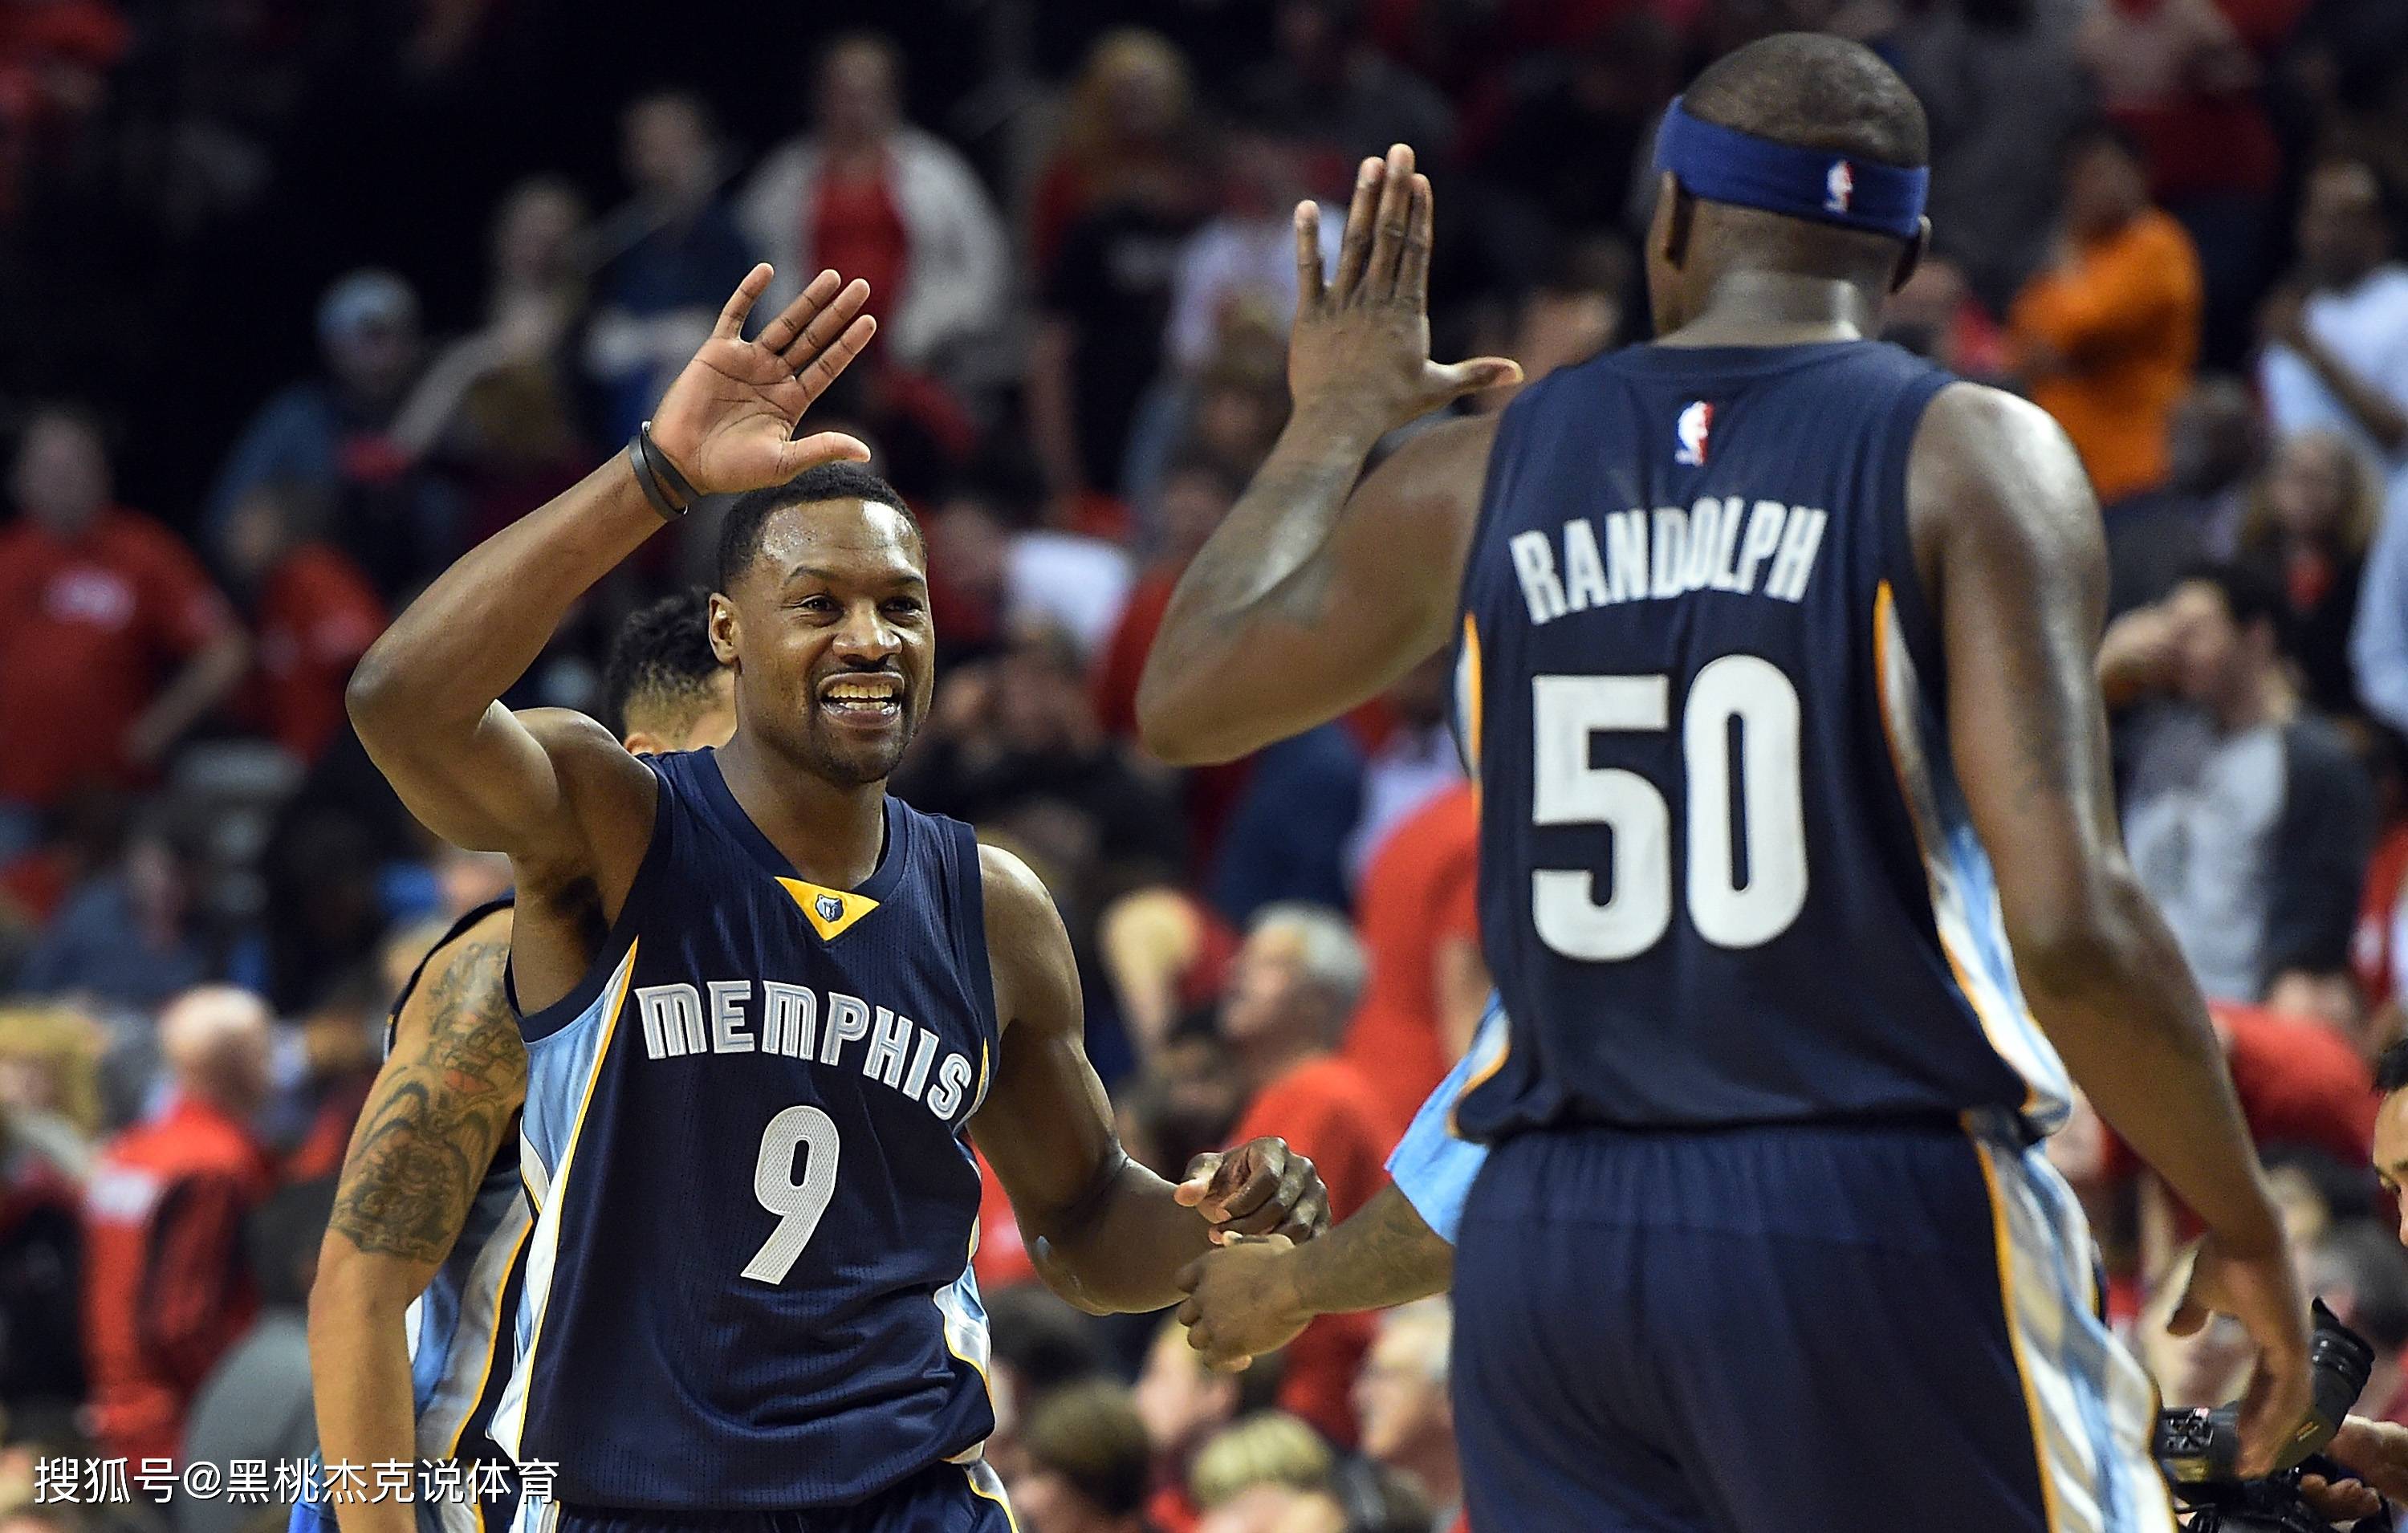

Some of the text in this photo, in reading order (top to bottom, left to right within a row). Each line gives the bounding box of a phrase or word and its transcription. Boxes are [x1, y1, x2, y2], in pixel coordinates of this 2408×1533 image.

[1509, 496, 1828, 625] RANDOLPH
[1531, 654, 1810, 962] 50
[635, 980, 972, 1120] MEMPHIS
[741, 1105, 840, 1285] 9
